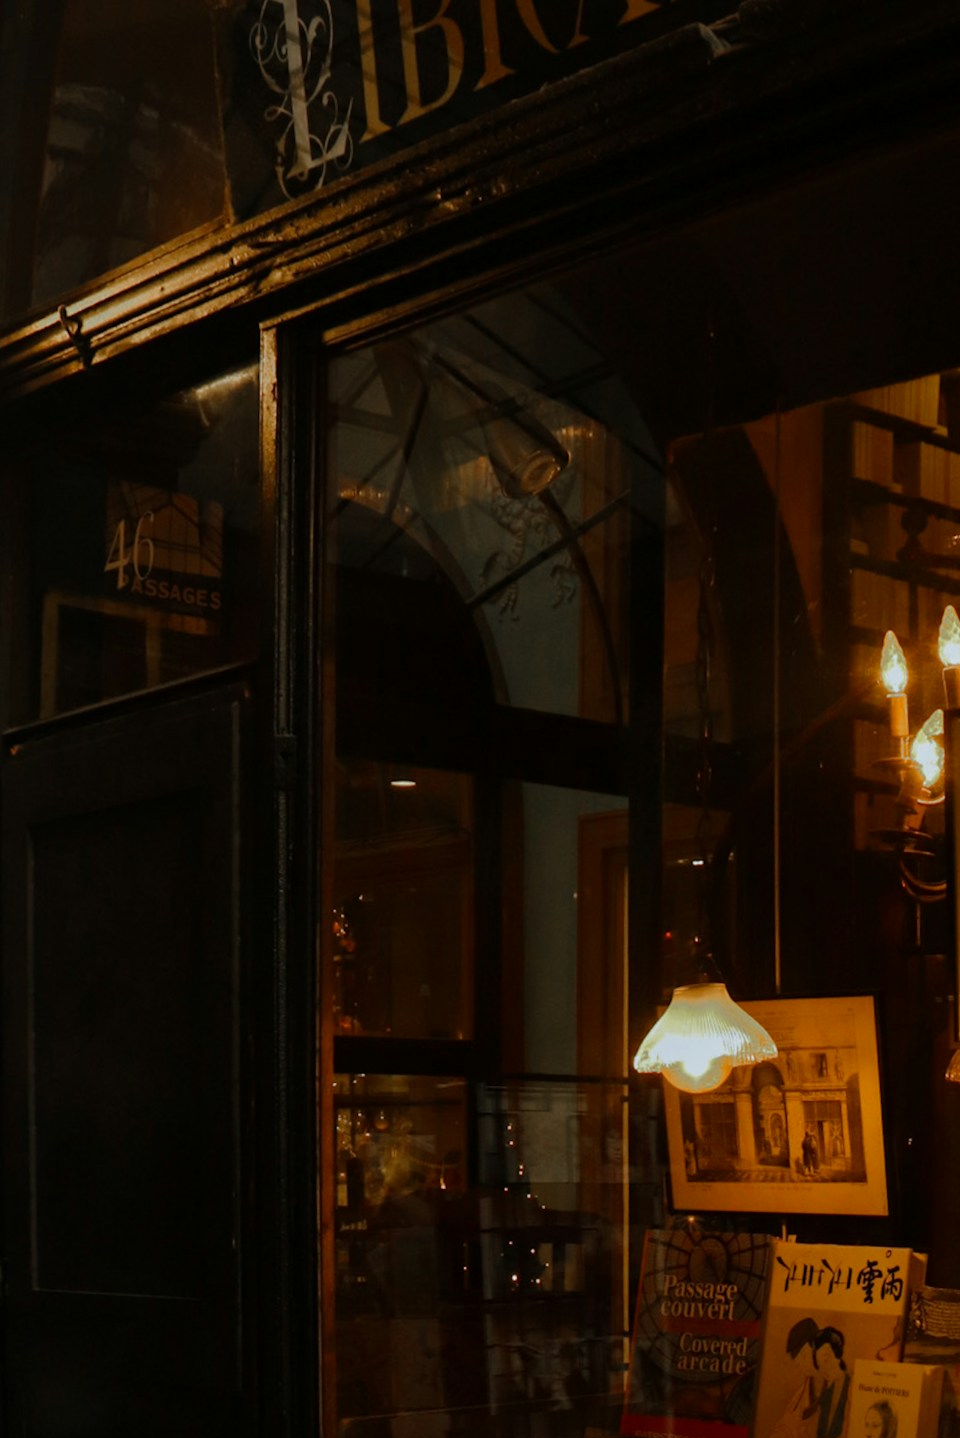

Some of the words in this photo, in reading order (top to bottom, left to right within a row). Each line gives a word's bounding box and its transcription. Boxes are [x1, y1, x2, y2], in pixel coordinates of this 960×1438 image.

[662, 1274, 738, 1302] Passage
[660, 1297, 736, 1321] couvert
[680, 1332, 748, 1357] Covered
[676, 1356, 747, 1375] arcade
